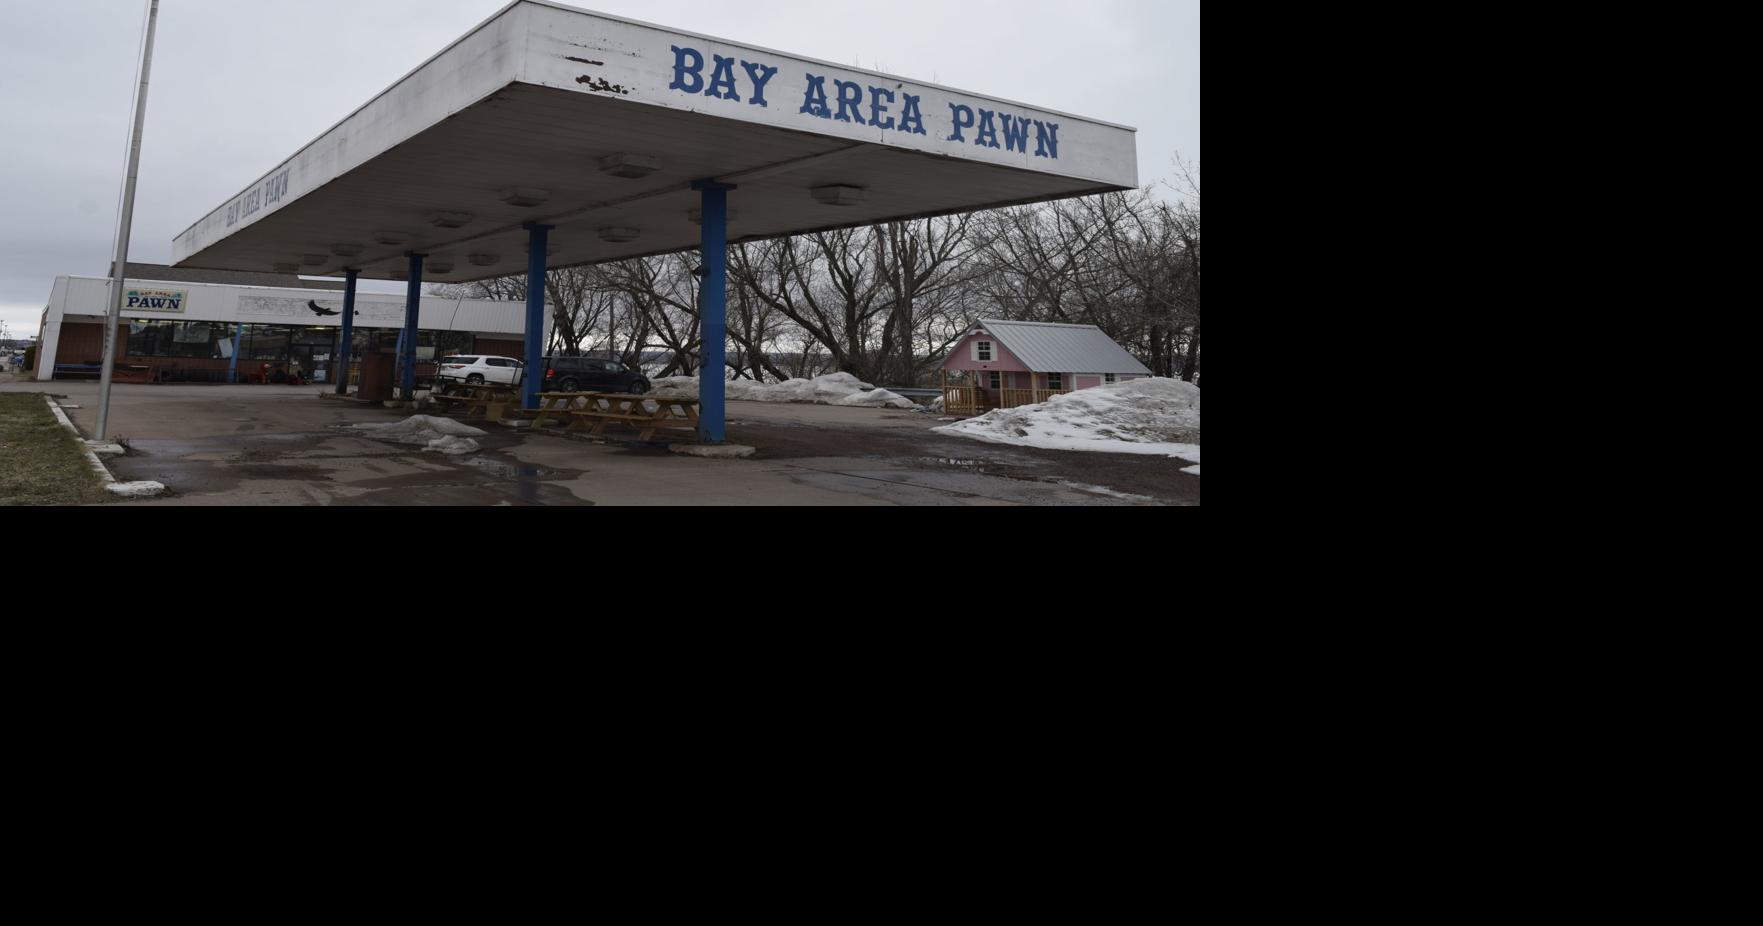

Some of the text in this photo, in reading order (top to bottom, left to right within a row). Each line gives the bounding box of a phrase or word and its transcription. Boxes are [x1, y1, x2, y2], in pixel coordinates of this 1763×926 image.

[669, 44, 1059, 158] BAY AREA PAWN
[264, 169, 289, 206] PAWN
[126, 297, 181, 309] PAWN
